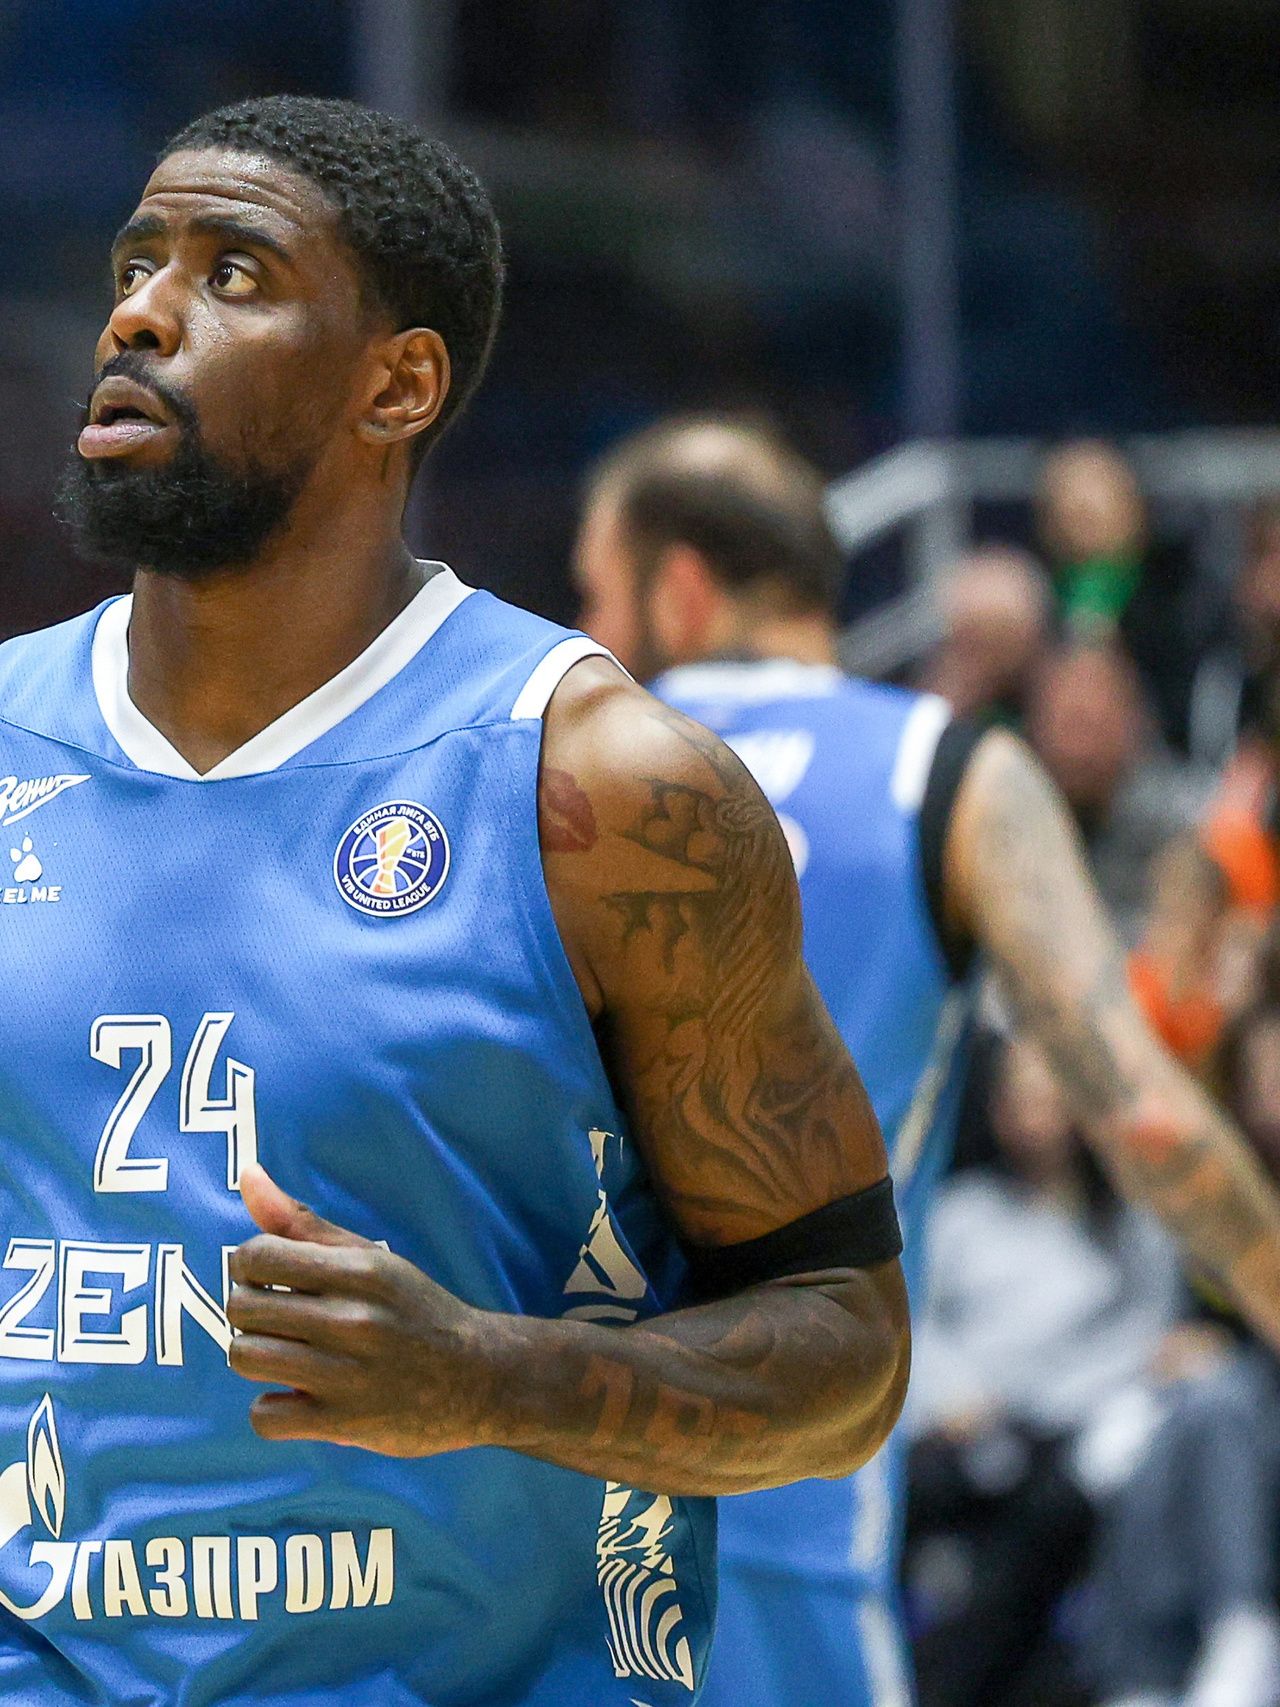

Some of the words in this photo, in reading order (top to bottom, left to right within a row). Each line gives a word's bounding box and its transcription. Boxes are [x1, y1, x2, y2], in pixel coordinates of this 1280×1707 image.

[353, 805, 397, 835] ЕДИНАЯ
[397, 805, 425, 821] ЛИГА
[423, 821, 440, 842] ВТБ
[341, 873, 354, 895] VTB
[352, 892, 391, 910] UNITED
[392, 882, 431, 909] LEAGUE
[90, 1011, 259, 1193] 24
[71, 1528, 395, 1621] ГАЗПРОМ
